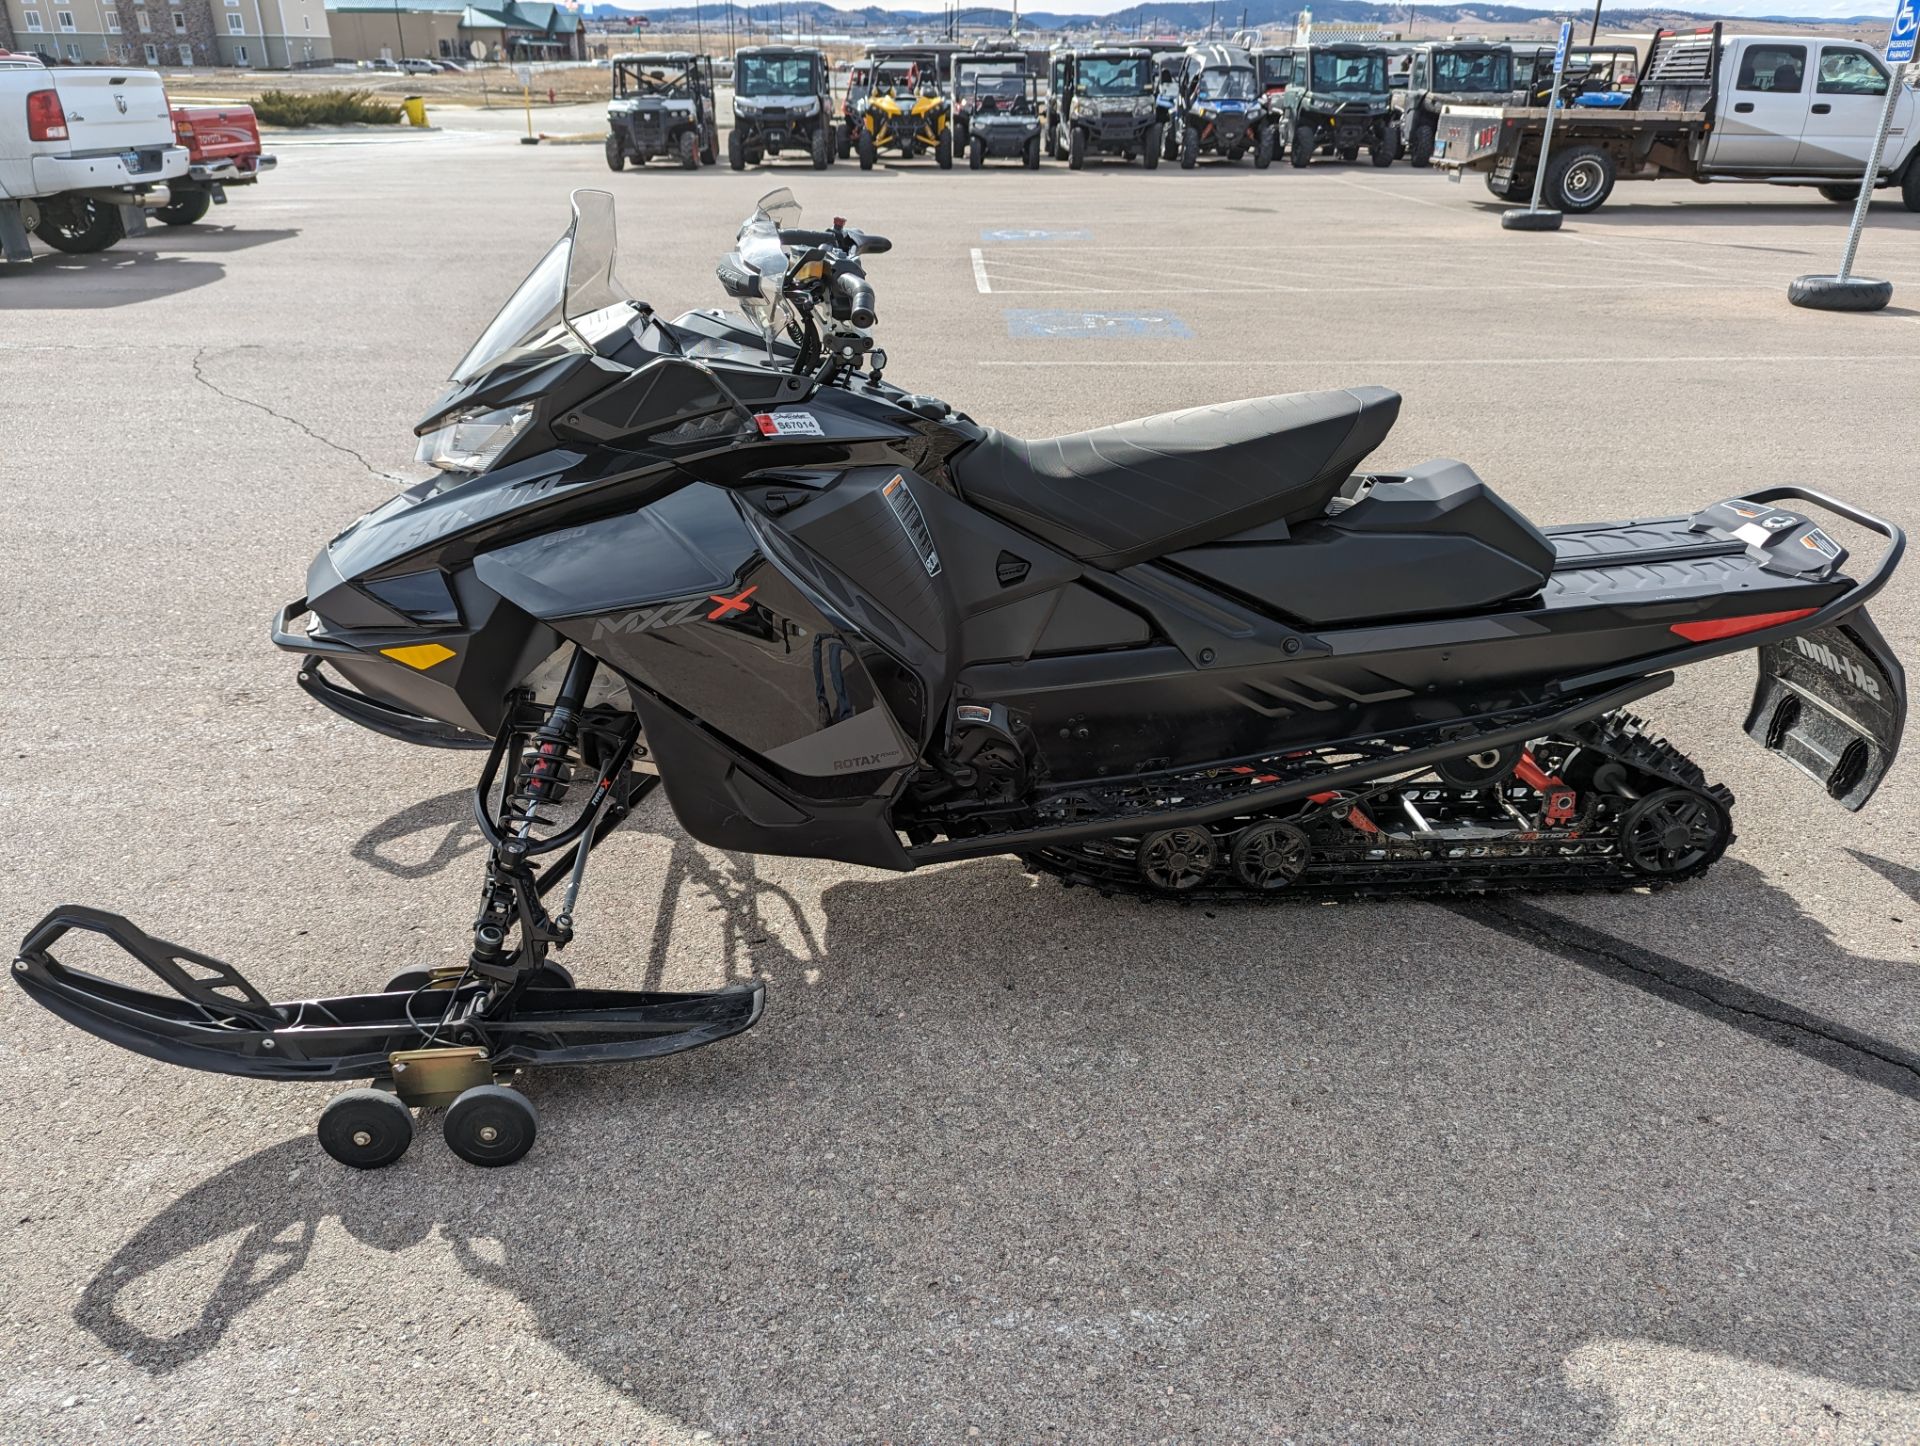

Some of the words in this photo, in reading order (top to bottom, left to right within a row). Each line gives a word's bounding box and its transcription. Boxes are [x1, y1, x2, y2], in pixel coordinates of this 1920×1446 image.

[591, 598, 709, 641] MXZ
[706, 585, 758, 621] X
[833, 753, 881, 770] ROTAX
